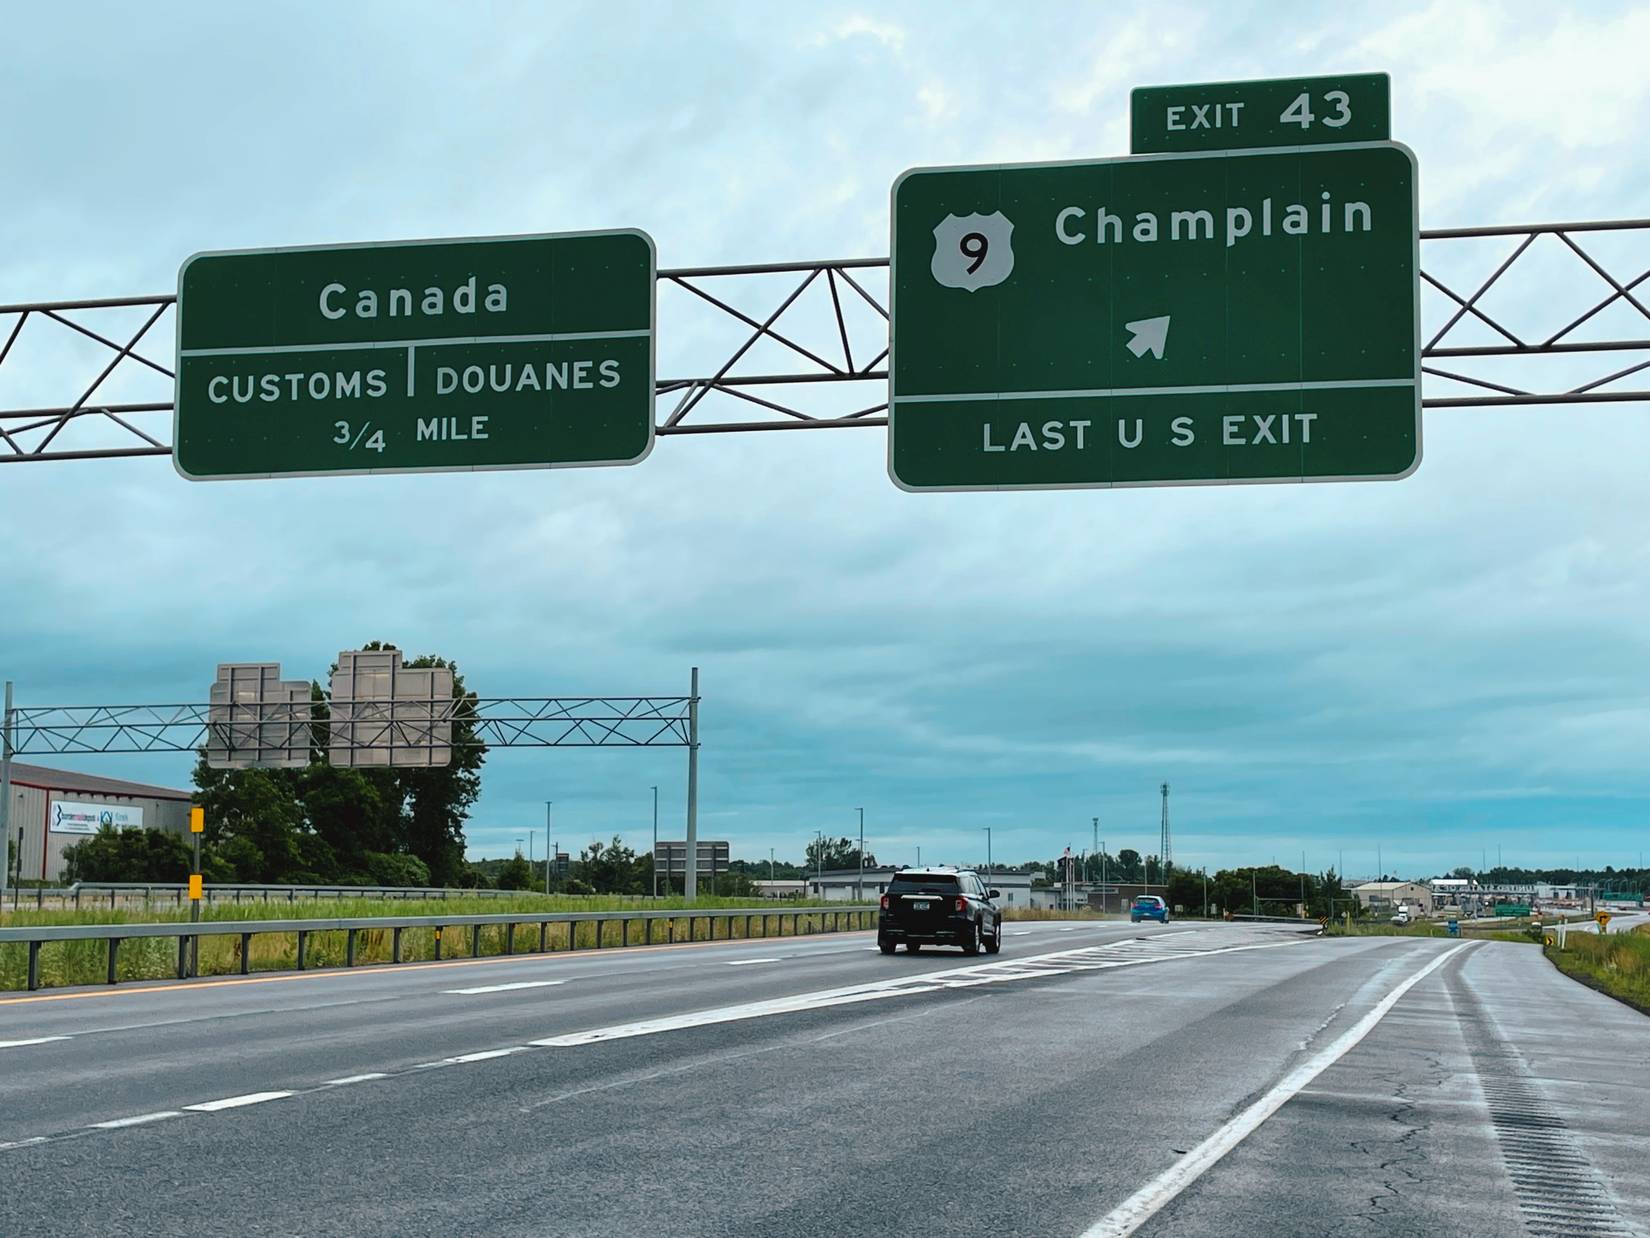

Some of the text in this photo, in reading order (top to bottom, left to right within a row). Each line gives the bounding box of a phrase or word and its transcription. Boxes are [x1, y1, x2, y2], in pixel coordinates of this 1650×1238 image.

[1166, 90, 1352, 131] EXIT 43
[1055, 191, 1373, 247] Champlain
[959, 232, 989, 275] 9
[318, 276, 507, 320] Canada
[208, 369, 387, 403] CUSTOMS
[436, 359, 621, 395] DOUANES
[333, 415, 489, 453] 3/4 MILE
[982, 413, 1318, 453] LAST U S EXIT
